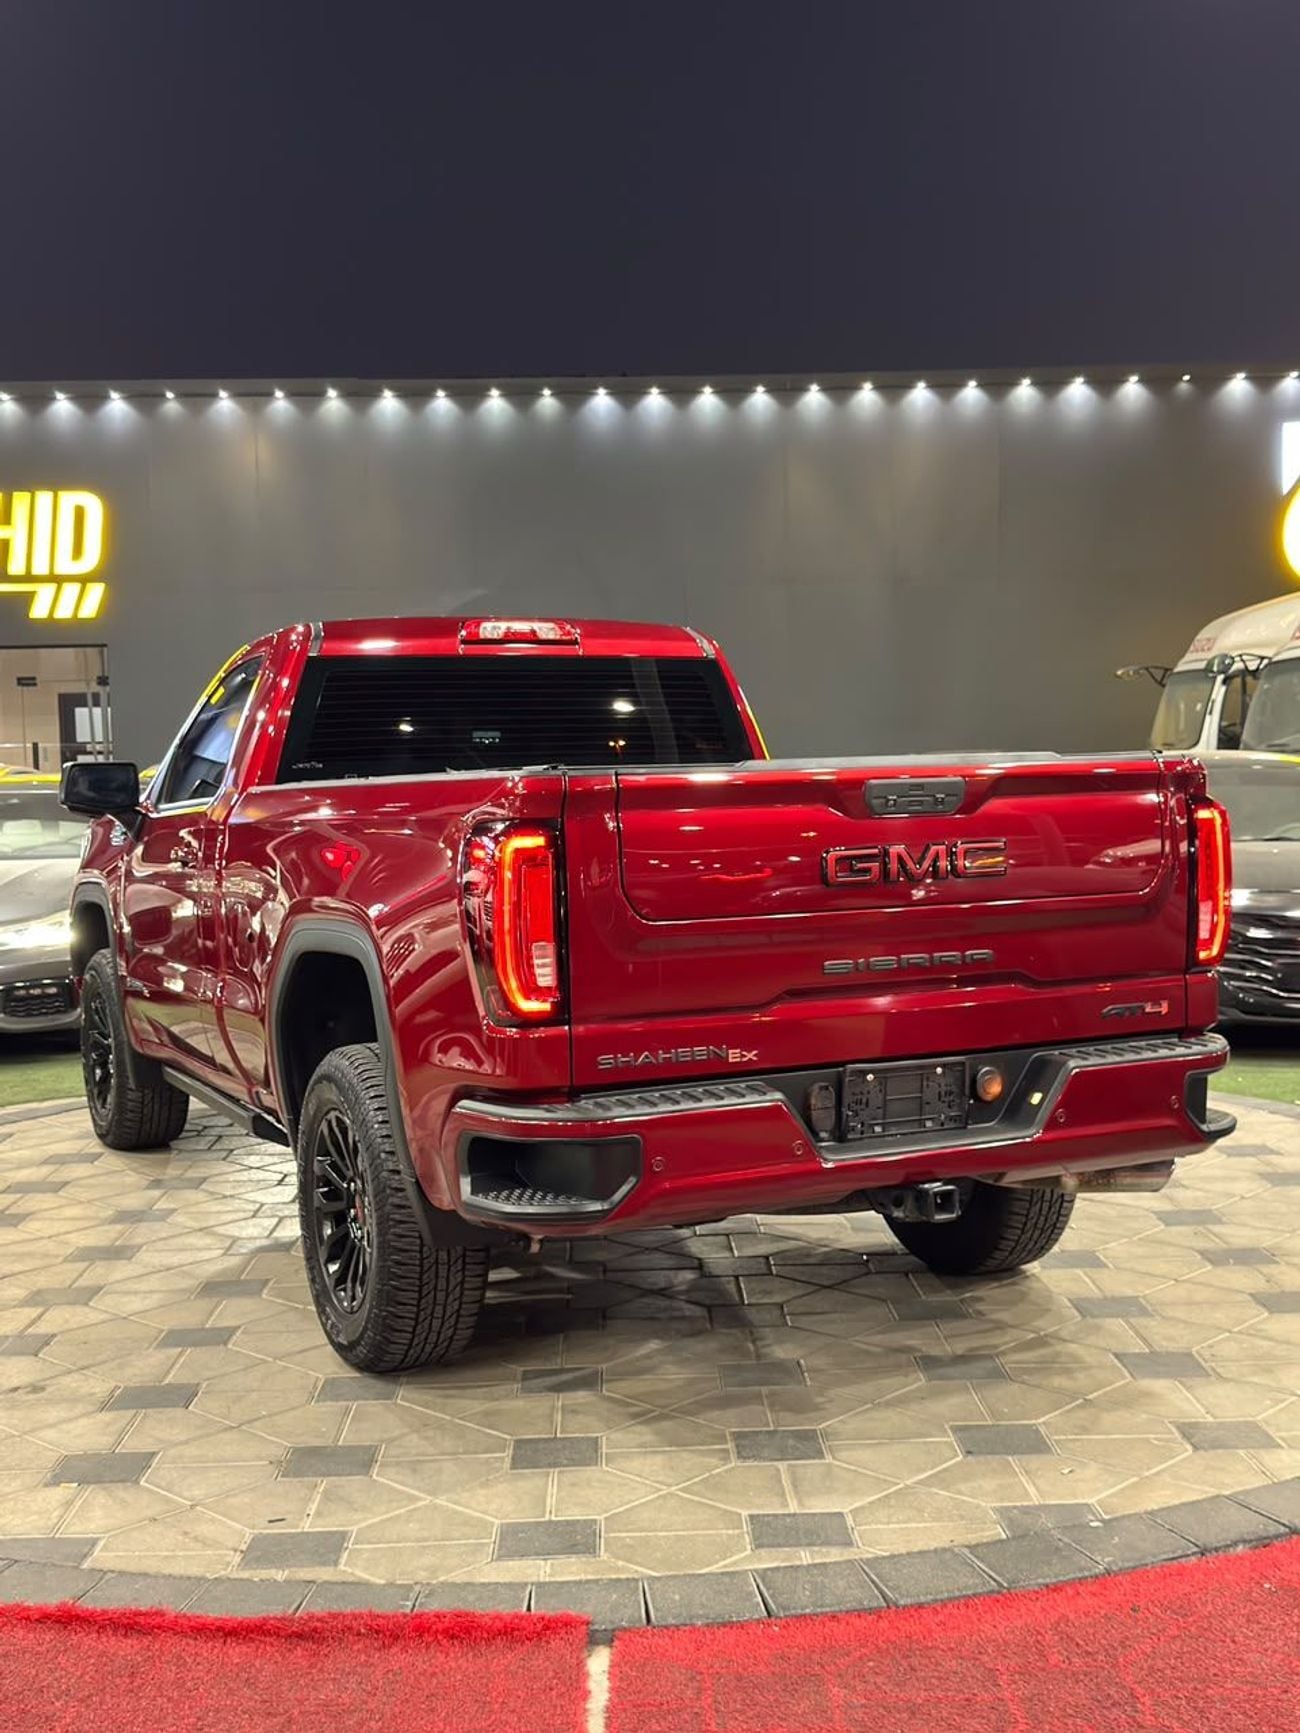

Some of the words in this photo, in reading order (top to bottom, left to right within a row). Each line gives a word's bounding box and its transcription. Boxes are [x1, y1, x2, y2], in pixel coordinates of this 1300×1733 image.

[821, 838, 1007, 887] GMC
[823, 949, 994, 975] SIERRA
[1101, 1000, 1169, 1019] AT4
[596, 1044, 728, 1069] SHAHEEN
